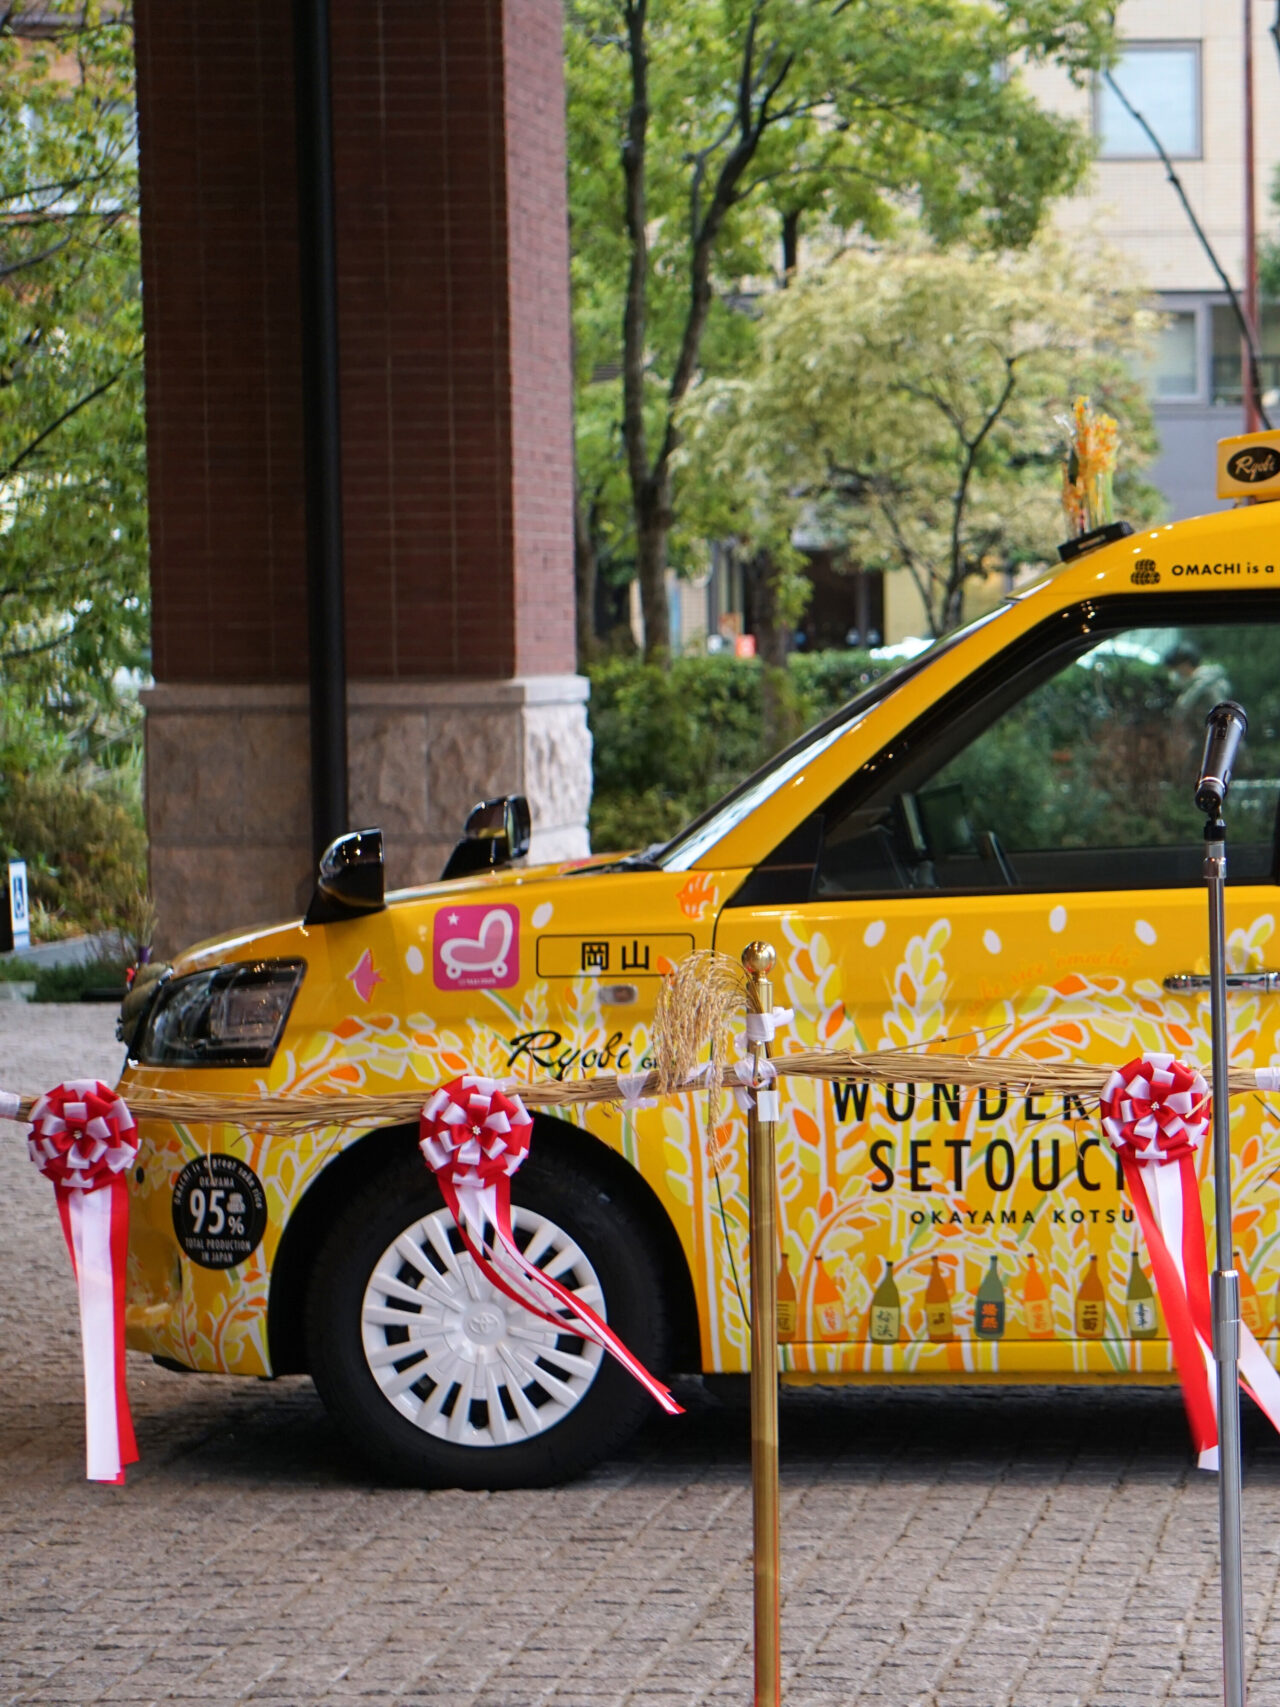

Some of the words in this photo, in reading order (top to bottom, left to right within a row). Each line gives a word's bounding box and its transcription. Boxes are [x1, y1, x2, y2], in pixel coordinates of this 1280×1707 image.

[1171, 562, 1242, 577] OMACHI
[1246, 561, 1260, 575] is
[1265, 563, 1275, 574] a
[581, 940, 651, 972] 岡山
[507, 1030, 634, 1082] Ryobi
[869, 1138, 1126, 1193] SETOUC
[910, 1209, 1037, 1225] OKAYAMA
[1053, 1208, 1135, 1224] KOTSU
